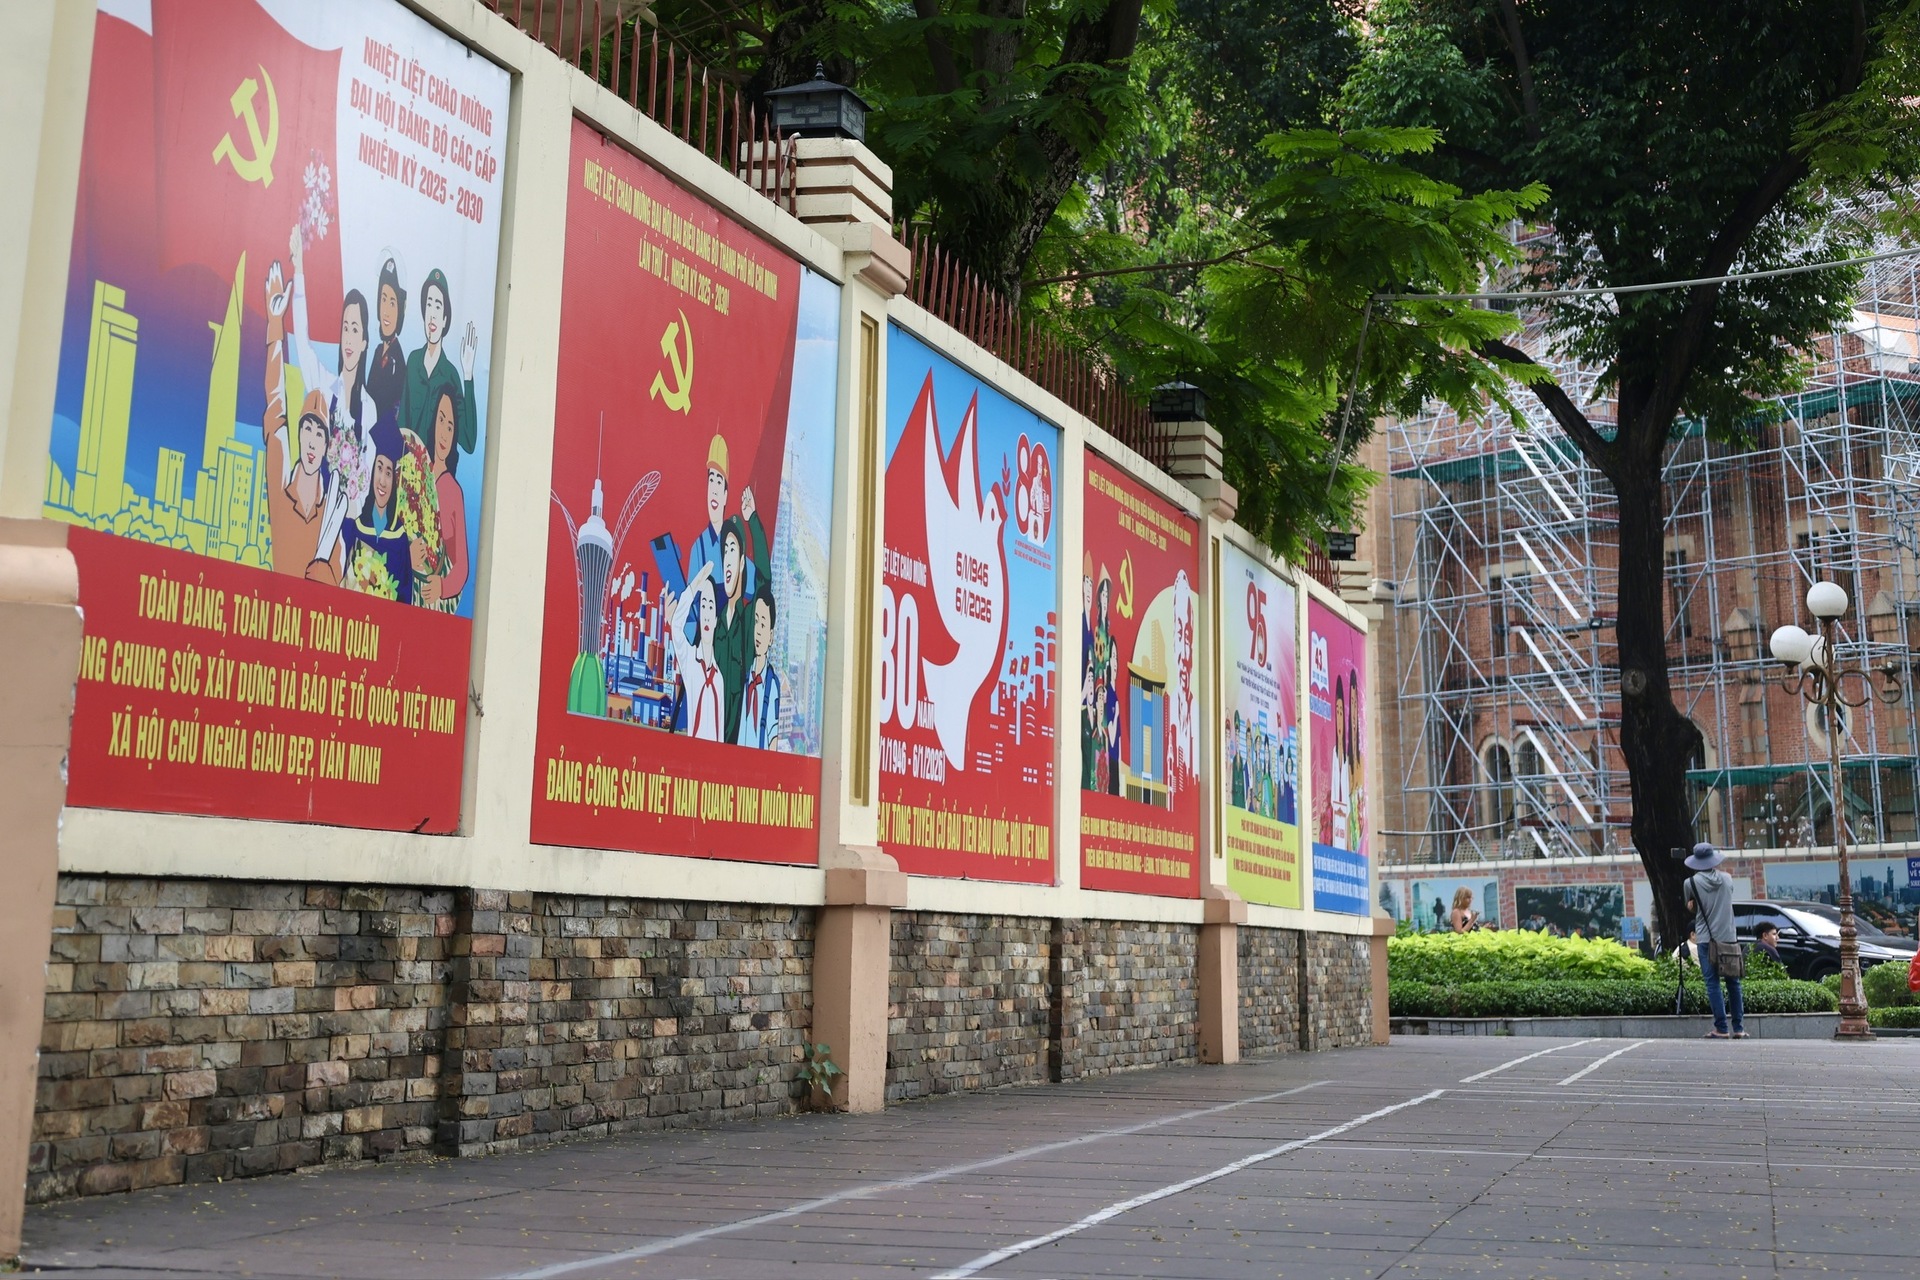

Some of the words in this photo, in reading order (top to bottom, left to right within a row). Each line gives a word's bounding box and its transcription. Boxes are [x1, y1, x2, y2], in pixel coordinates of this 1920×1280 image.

[364, 36, 399, 84] NHIỆT
[401, 58, 425, 99] LIỆT
[428, 75, 457, 116] CHÀO
[460, 94, 492, 137] MỪNG
[350, 77, 372, 119] ĐẠI
[375, 91, 396, 132] HỘI
[398, 101, 430, 148] ĐẢNG
[432, 123, 448, 163] BỘ
[451, 135, 473, 172] CÁC
[475, 146, 497, 183] CẤP
[358, 132, 399, 180] NHIỆM
[401, 154, 418, 188] KỲ
[419, 166, 447, 205] 2025
[456, 186, 483, 224] 2030
[603, 167, 616, 209] LIỆT
[698, 273, 711, 306] 2025
[138, 569, 180, 623] TOÀN
[182, 573, 227, 638] ĐẢNG,
[233, 589, 269, 639] TOÀN
[271, 597, 303, 651] DÂN,
[308, 606, 342, 653] TOÀN
[345, 614, 380, 662] QUÂN
[1246, 581, 1268, 668] 95
[111, 641, 166, 691] CHUNG
[170, 644, 201, 696] SỨC
[204, 651, 235, 700] XÂY
[237, 662, 276, 713] DỰNG
[279, 661, 297, 710] VÀ
[301, 661, 328, 715] BẢO
[330, 673, 347, 727] VỆ
[350, 668, 368, 721] TỔ
[367, 674, 400, 727] QUỐC
[402, 685, 428, 738] VIỆT
[429, 698, 456, 734] NAM
[917, 696, 935, 730] NĂM
[108, 705, 133, 757] XÃ
[135, 708, 165, 770] HỘI
[167, 709, 200, 764] CHỦ
[202, 719, 247, 769] NGHĨA
[251, 723, 285, 774] GIÀU
[286, 735, 315, 784] ĐẸP,
[319, 732, 346, 780] VĂN
[347, 743, 382, 785] MINH
[546, 745, 582, 804] ĐẢNG
[585, 756, 619, 816] CỘNG
[621, 756, 645, 811] SẢN
[647, 766, 672, 823] VIỆT
[673, 777, 699, 818] NAM
[700, 781, 734, 824] QUANG
[736, 786, 759, 824] VINH
[760, 783, 788, 827] MUÔN
[790, 786, 814, 829] NĂM!
[892, 788, 911, 845] TỔNG
